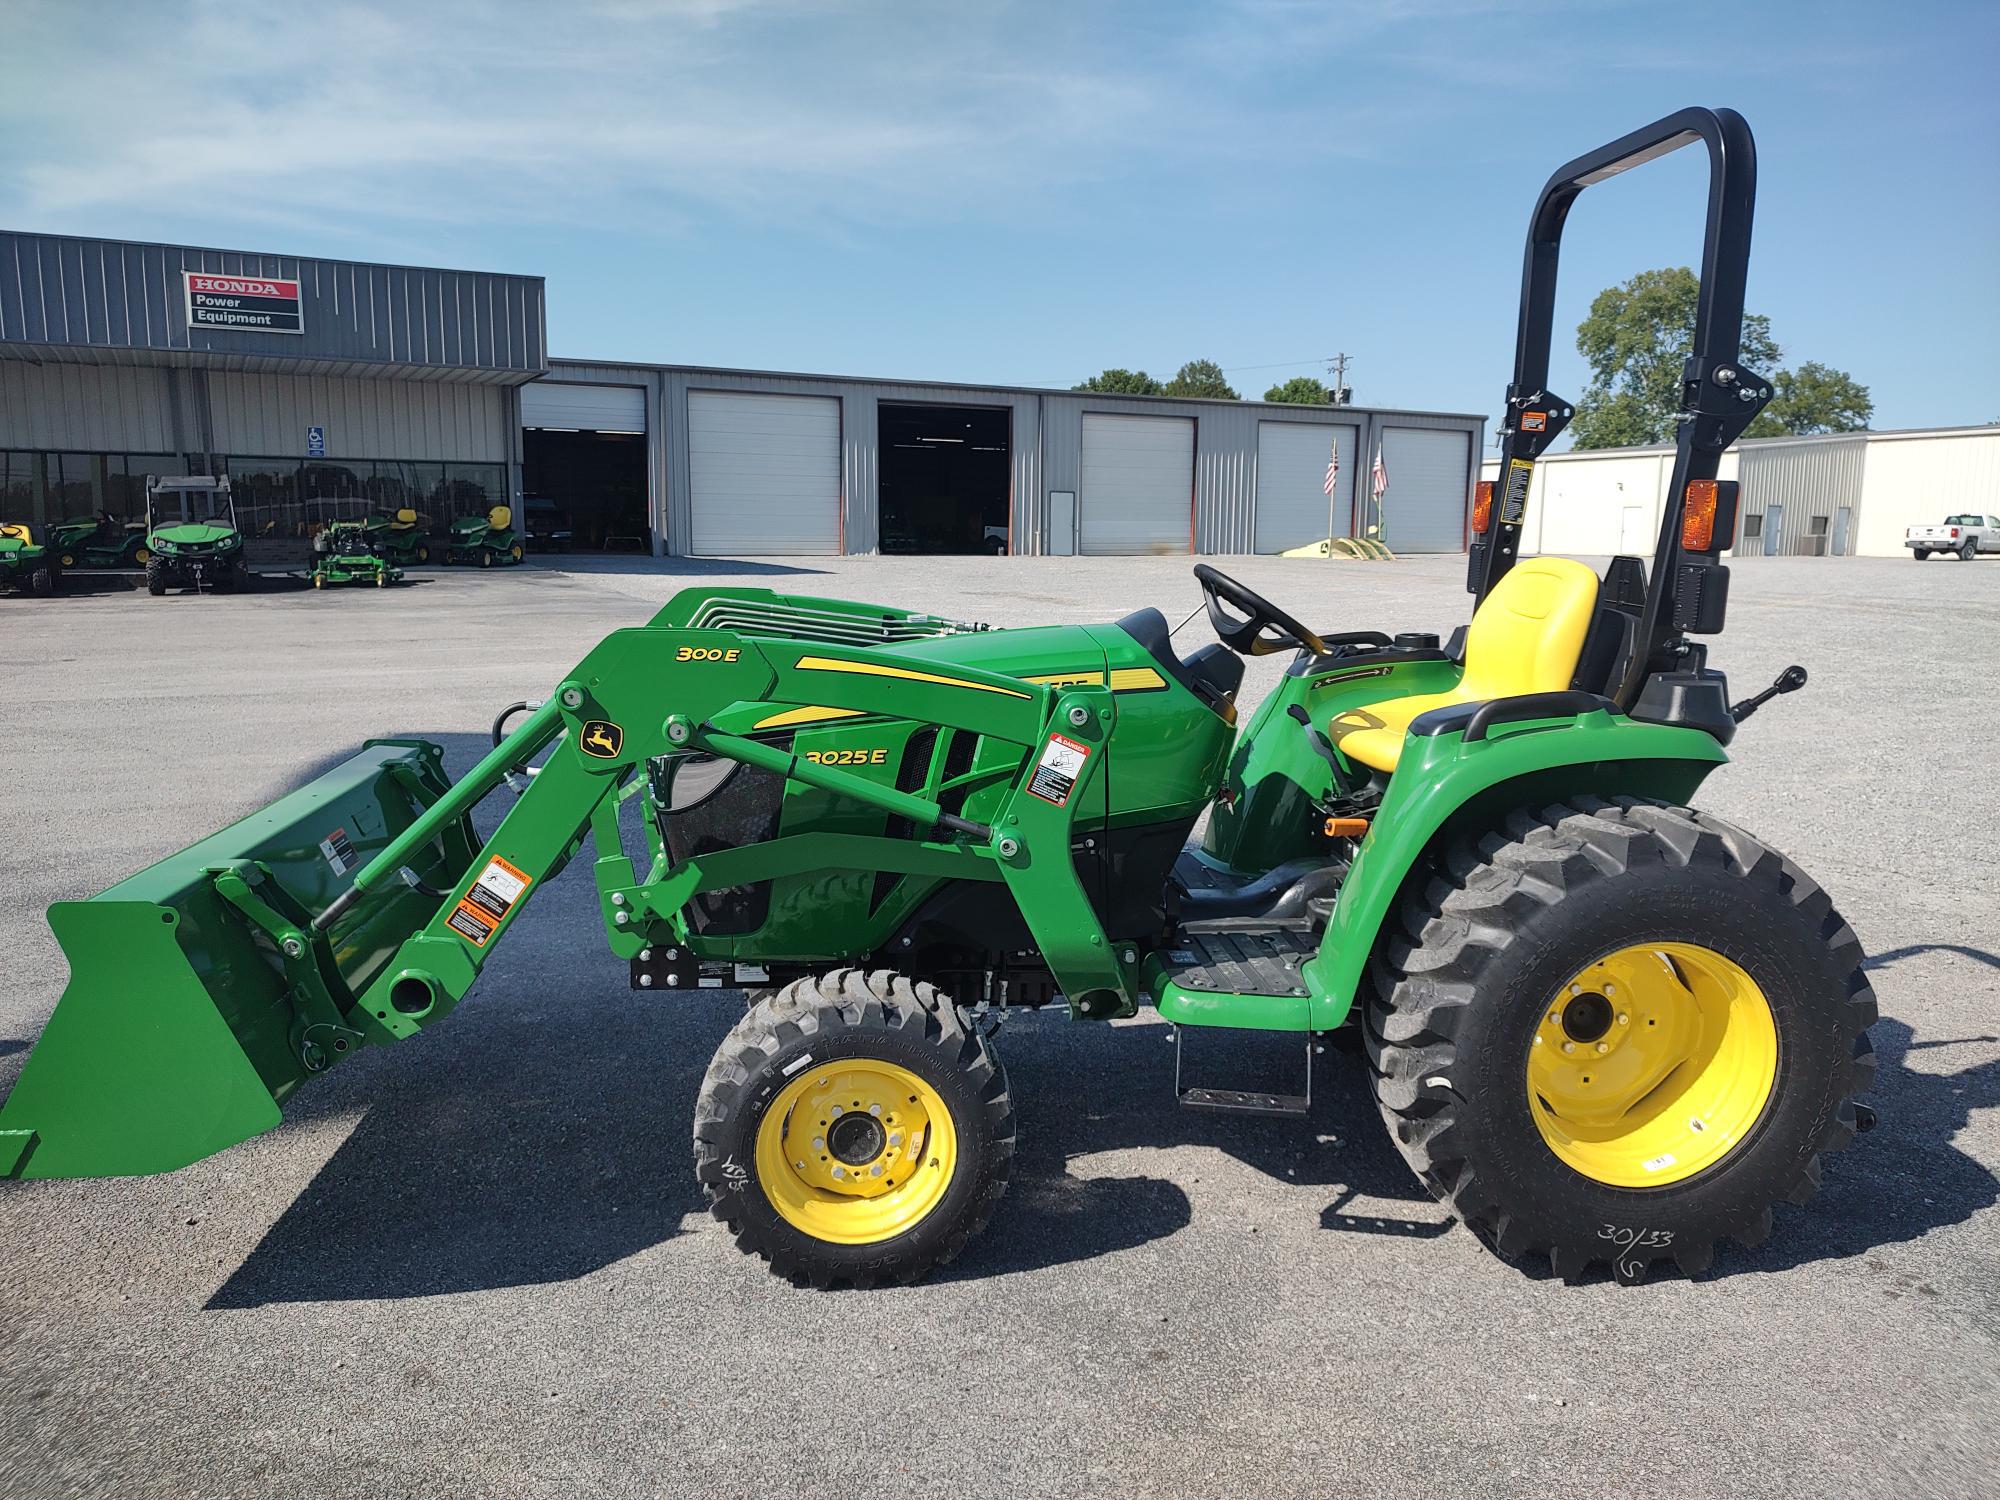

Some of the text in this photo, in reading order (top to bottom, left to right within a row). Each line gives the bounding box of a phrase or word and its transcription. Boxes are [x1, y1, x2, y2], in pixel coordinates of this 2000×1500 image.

[194, 278, 280, 295] HONDA
[196, 294, 241, 308] Power
[197, 309, 272, 325] Equipment
[502, 862, 527, 881] WARNING
[469, 907, 494, 927] WARNING
